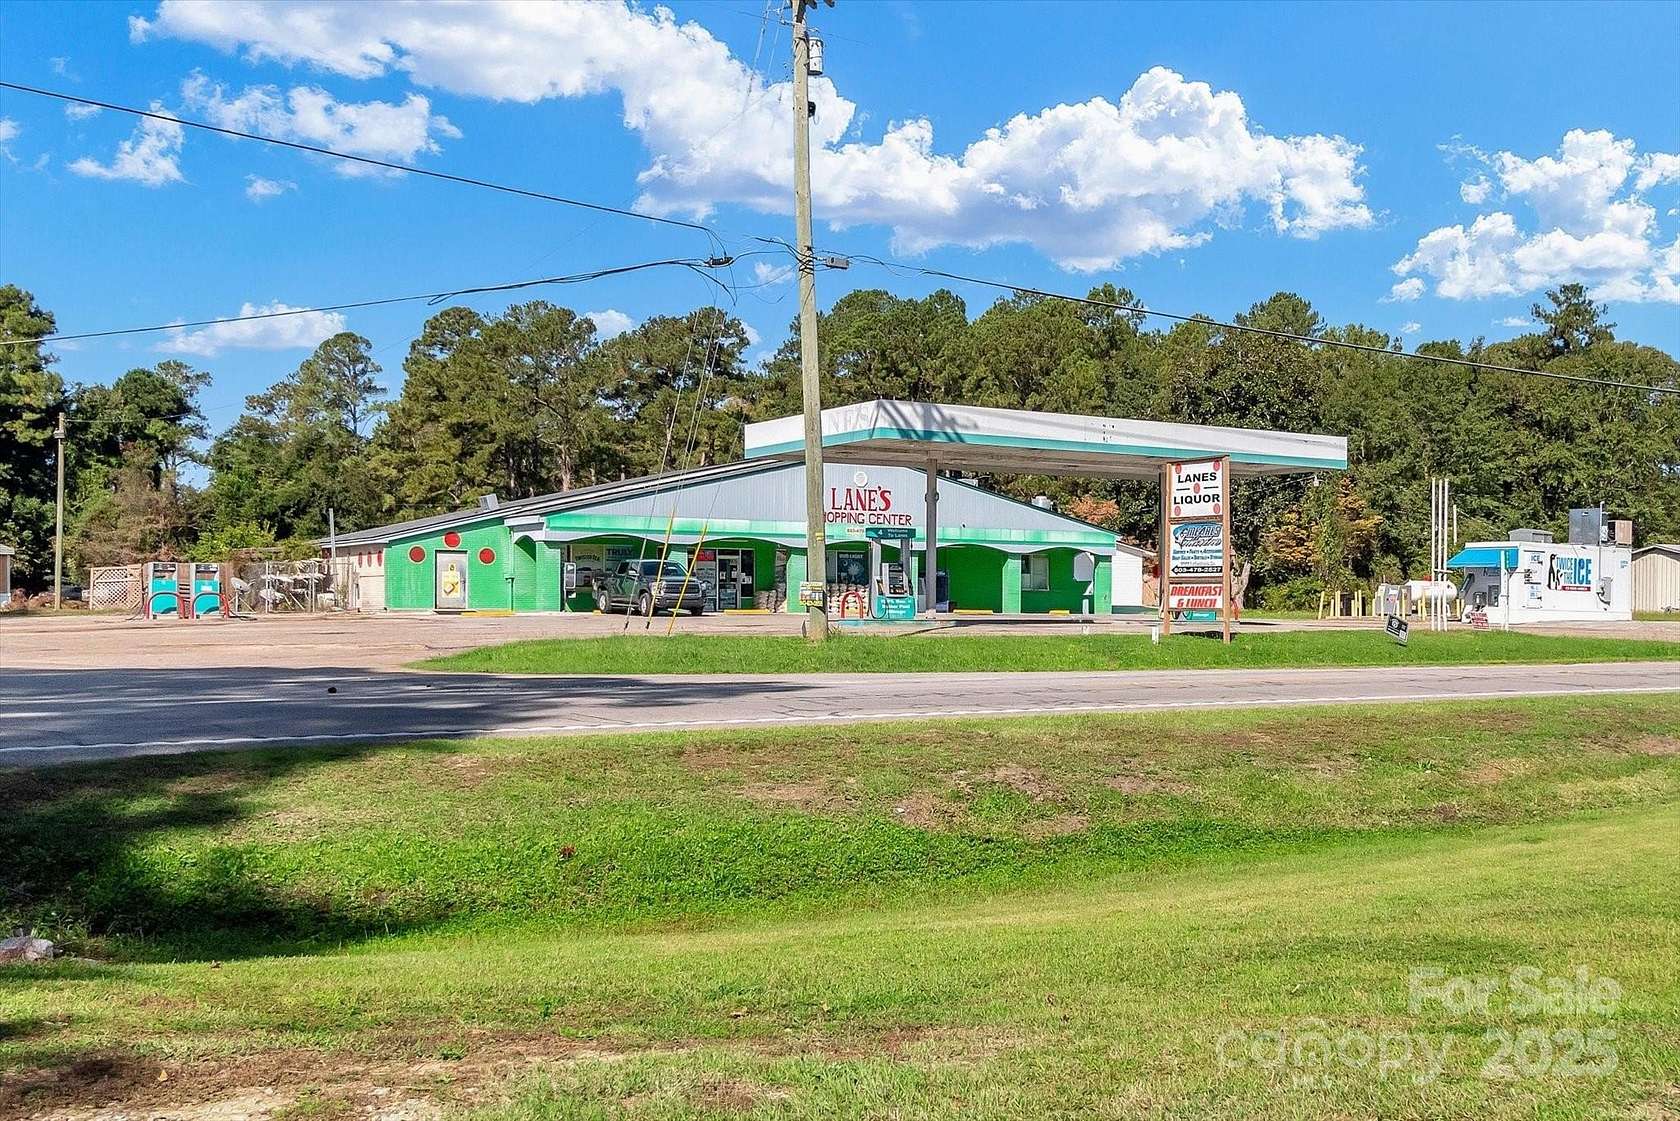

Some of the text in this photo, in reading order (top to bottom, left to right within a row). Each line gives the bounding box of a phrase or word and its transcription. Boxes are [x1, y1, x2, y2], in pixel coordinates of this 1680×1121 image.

[1177, 472, 1217, 484] LANES
[831, 485, 892, 512] LANE'S
[1173, 493, 1221, 505] LIQUOR
[868, 513, 912, 526] CENTER
[1556, 557, 1573, 571] TWICE
[1573, 558, 1592, 585] ICE
[1170, 586, 1222, 596] BREAKFAST
[1177, 598, 1217, 608] & LUNCH
